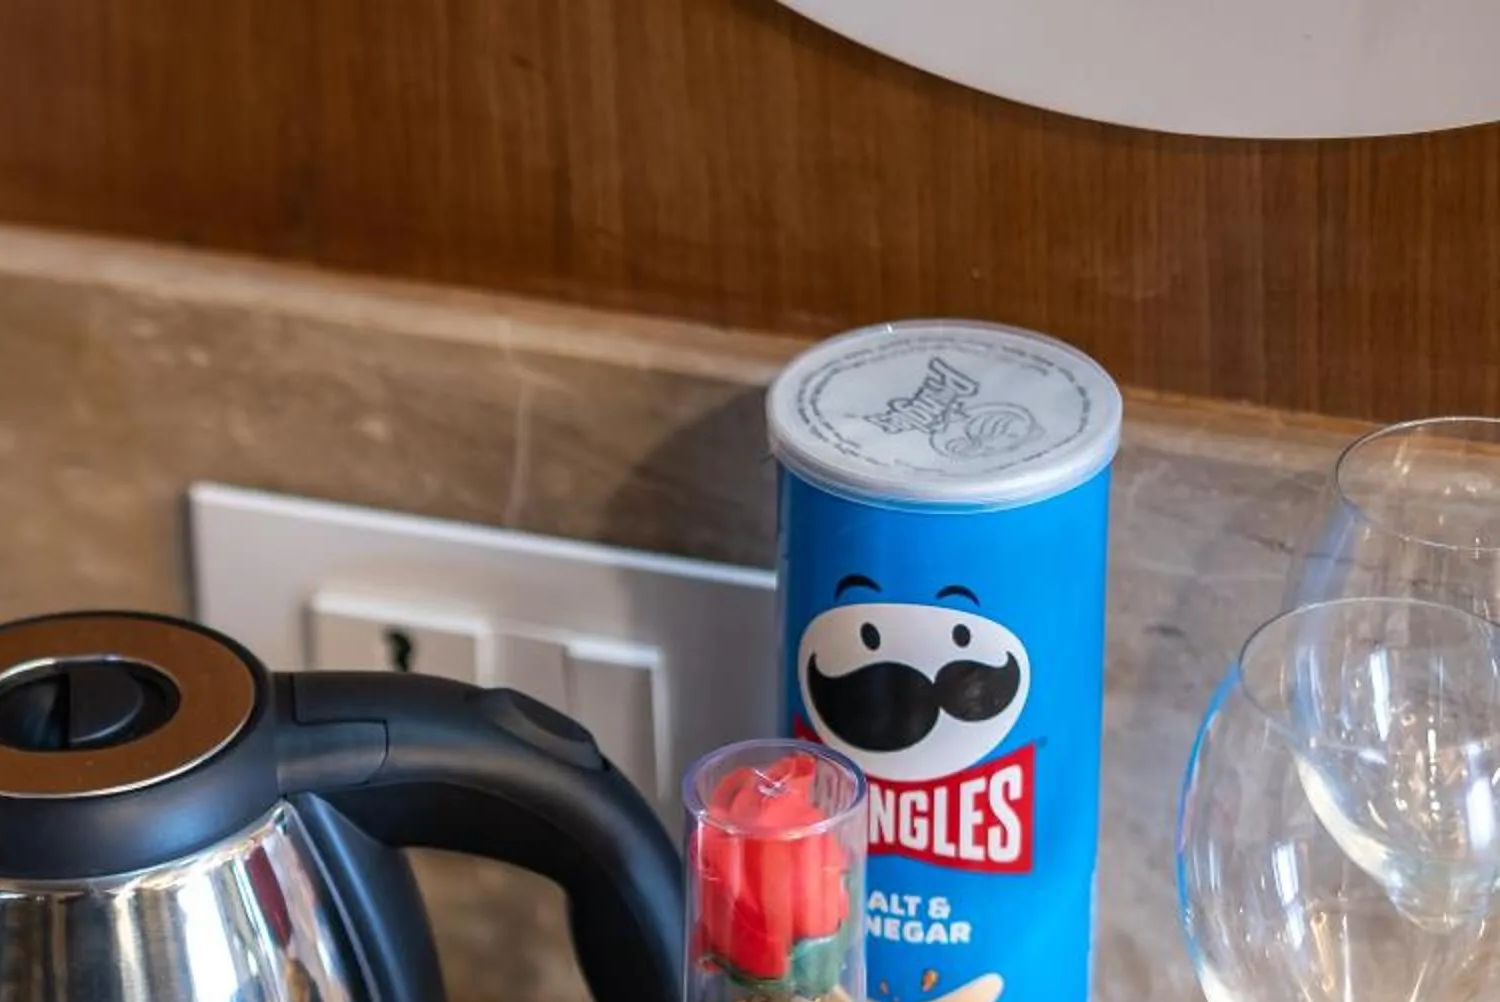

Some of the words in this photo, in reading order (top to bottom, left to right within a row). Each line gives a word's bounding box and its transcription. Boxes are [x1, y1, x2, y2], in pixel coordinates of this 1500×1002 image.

[867, 764, 1023, 864] NGLES
[867, 889, 921, 917] ALT
[928, 897, 950, 918] &
[866, 915, 972, 944] NEGAR
